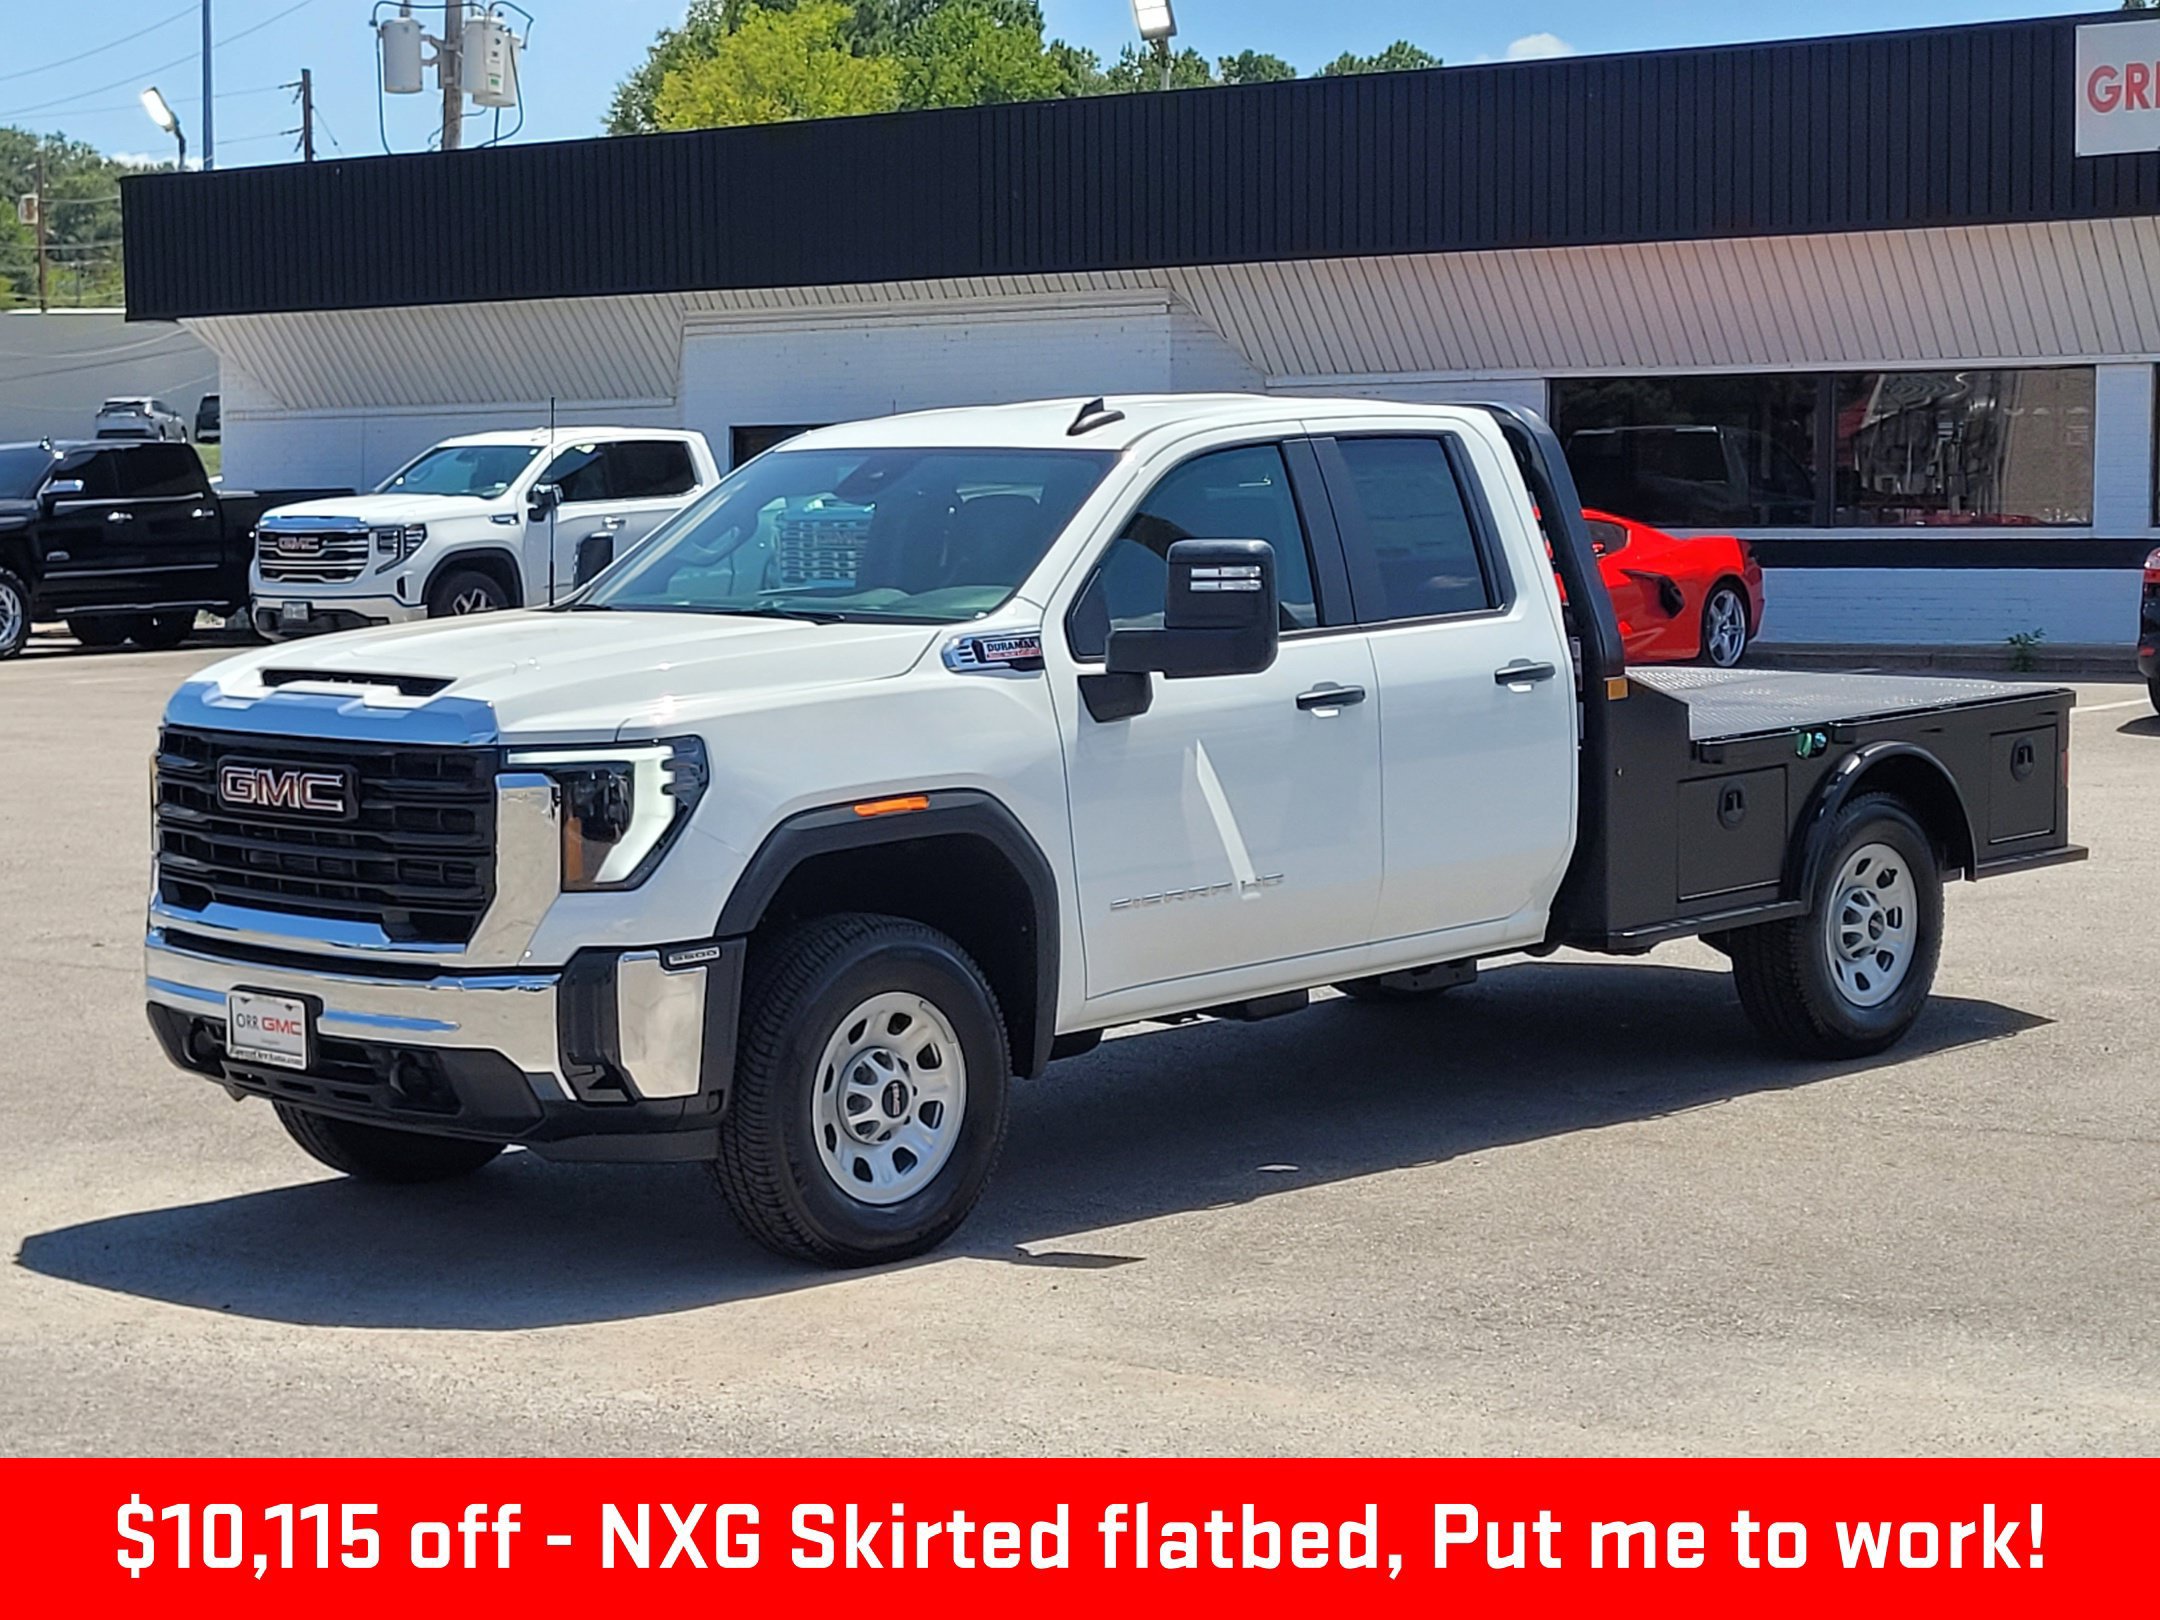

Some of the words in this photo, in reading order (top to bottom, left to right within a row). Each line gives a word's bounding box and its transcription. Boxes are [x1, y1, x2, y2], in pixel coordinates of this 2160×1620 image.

[278, 536, 319, 550] GMC
[986, 638, 1038, 653] DURAMAX
[221, 765, 344, 813] GMC
[236, 1012, 260, 1031] ORR
[261, 1016, 303, 1037] GMC
